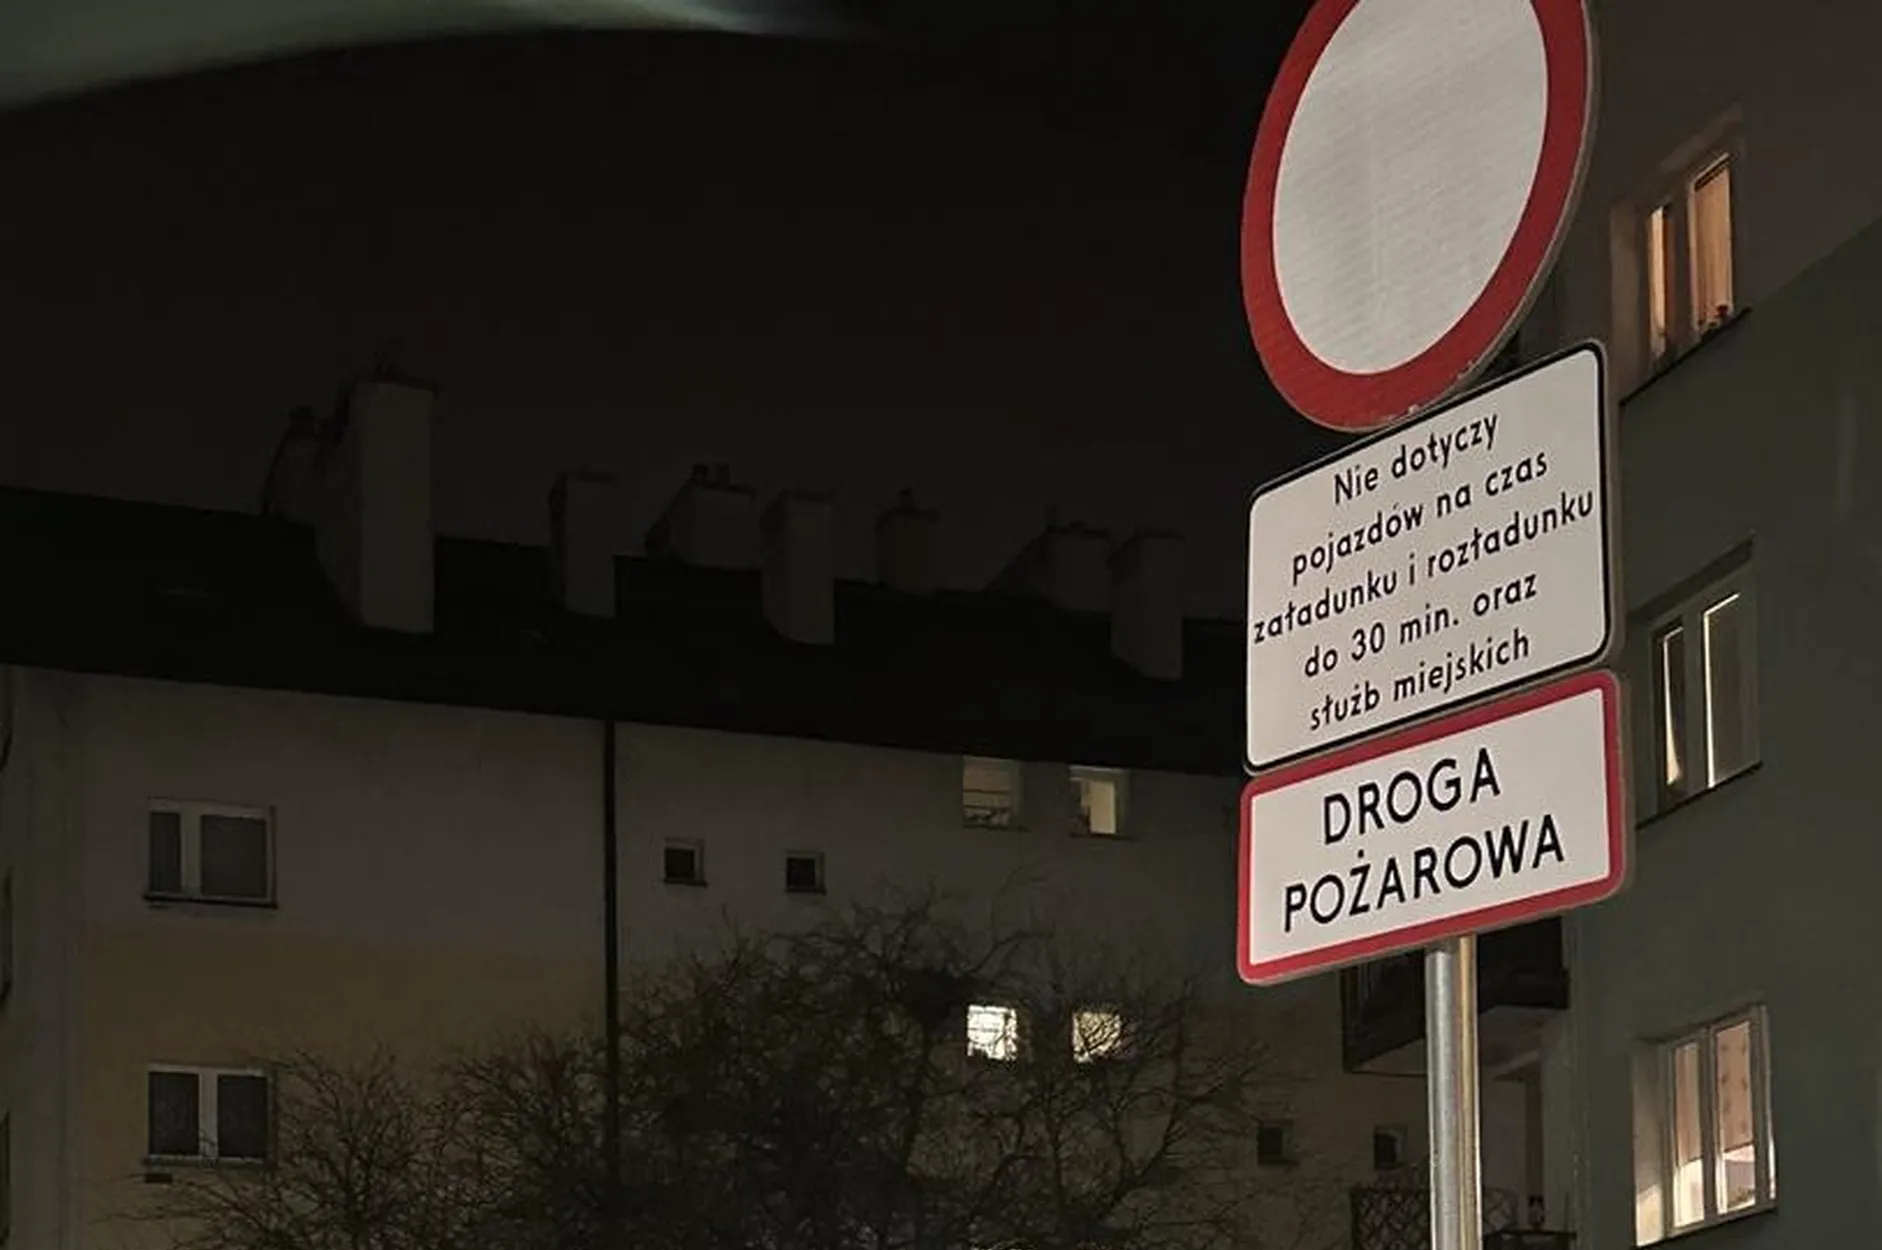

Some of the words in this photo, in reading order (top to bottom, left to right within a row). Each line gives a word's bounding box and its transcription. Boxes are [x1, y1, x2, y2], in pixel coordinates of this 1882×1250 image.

[1334, 464, 1379, 505] Nie
[1391, 413, 1498, 480] dotyczy
[1254, 570, 1397, 644] załadunku
[1409, 552, 1415, 586] i
[1427, 491, 1593, 578] rozładunku
[1292, 502, 1424, 587] pojazdów
[1436, 484, 1471, 519] na
[1485, 451, 1548, 497] czas
[1304, 645, 1338, 678] do
[1351, 622, 1385, 662] 30
[1399, 608, 1459, 645] min.
[1472, 573, 1537, 617] oraz
[1310, 680, 1380, 731] służb
[1393, 627, 1529, 702] miejskich
[1323, 747, 1501, 845] DROGA
[1284, 814, 1565, 933] POŻAROWA
